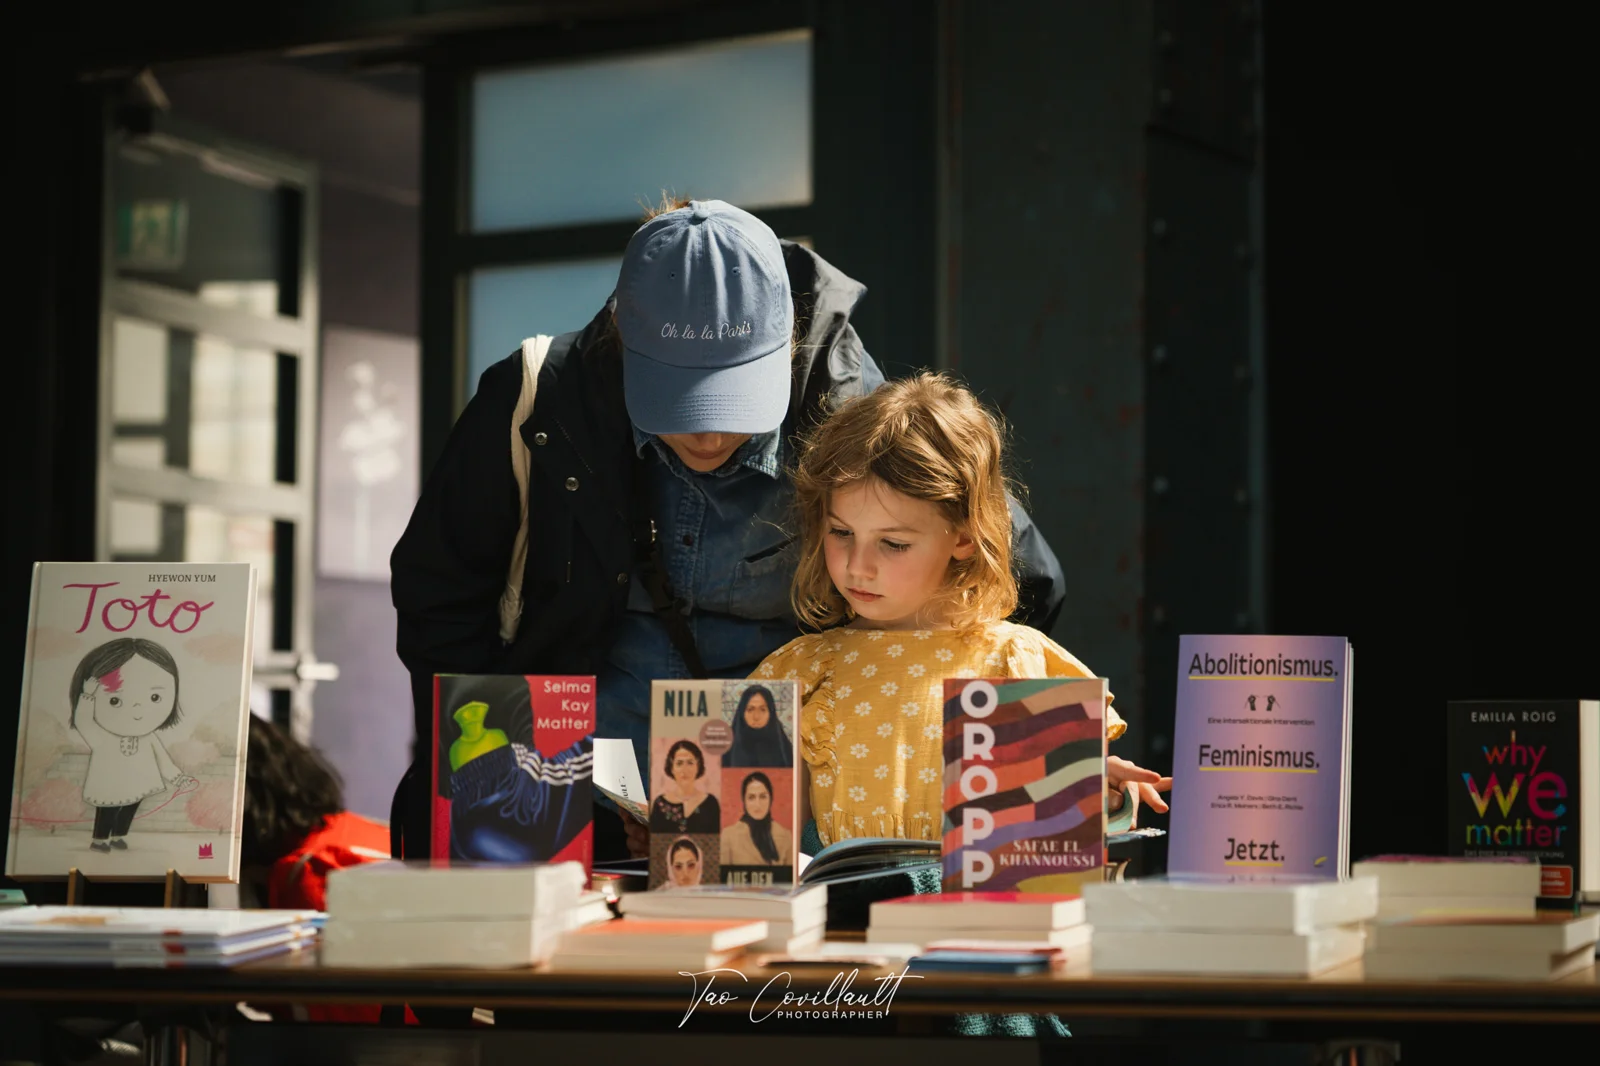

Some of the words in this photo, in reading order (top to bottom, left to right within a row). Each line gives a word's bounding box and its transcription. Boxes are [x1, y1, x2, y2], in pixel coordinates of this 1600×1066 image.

[661, 322, 678, 338] Oh
[681, 324, 697, 339] la
[700, 325, 715, 340] la
[719, 320, 752, 340] Paris
[148, 574, 193, 583] HYEWON
[194, 574, 217, 583] YUM
[63, 581, 214, 634] Toto
[1188, 652, 1339, 677] Abolitionismus.
[543, 680, 591, 694] Selma
[561, 699, 590, 713] Kay
[664, 690, 709, 717] NILA
[537, 717, 590, 730] Matter
[1471, 711, 1516, 723] EMILIA
[1522, 711, 1557, 723] ROIG
[1198, 744, 1320, 768] Feminismus.
[1482, 730, 1547, 776] why
[1466, 818, 1567, 847] matter
[1064, 840, 1082, 852] EL
[1224, 838, 1285, 861] Jetzt.
[999, 854, 1095, 867] KHANNOUSSI
